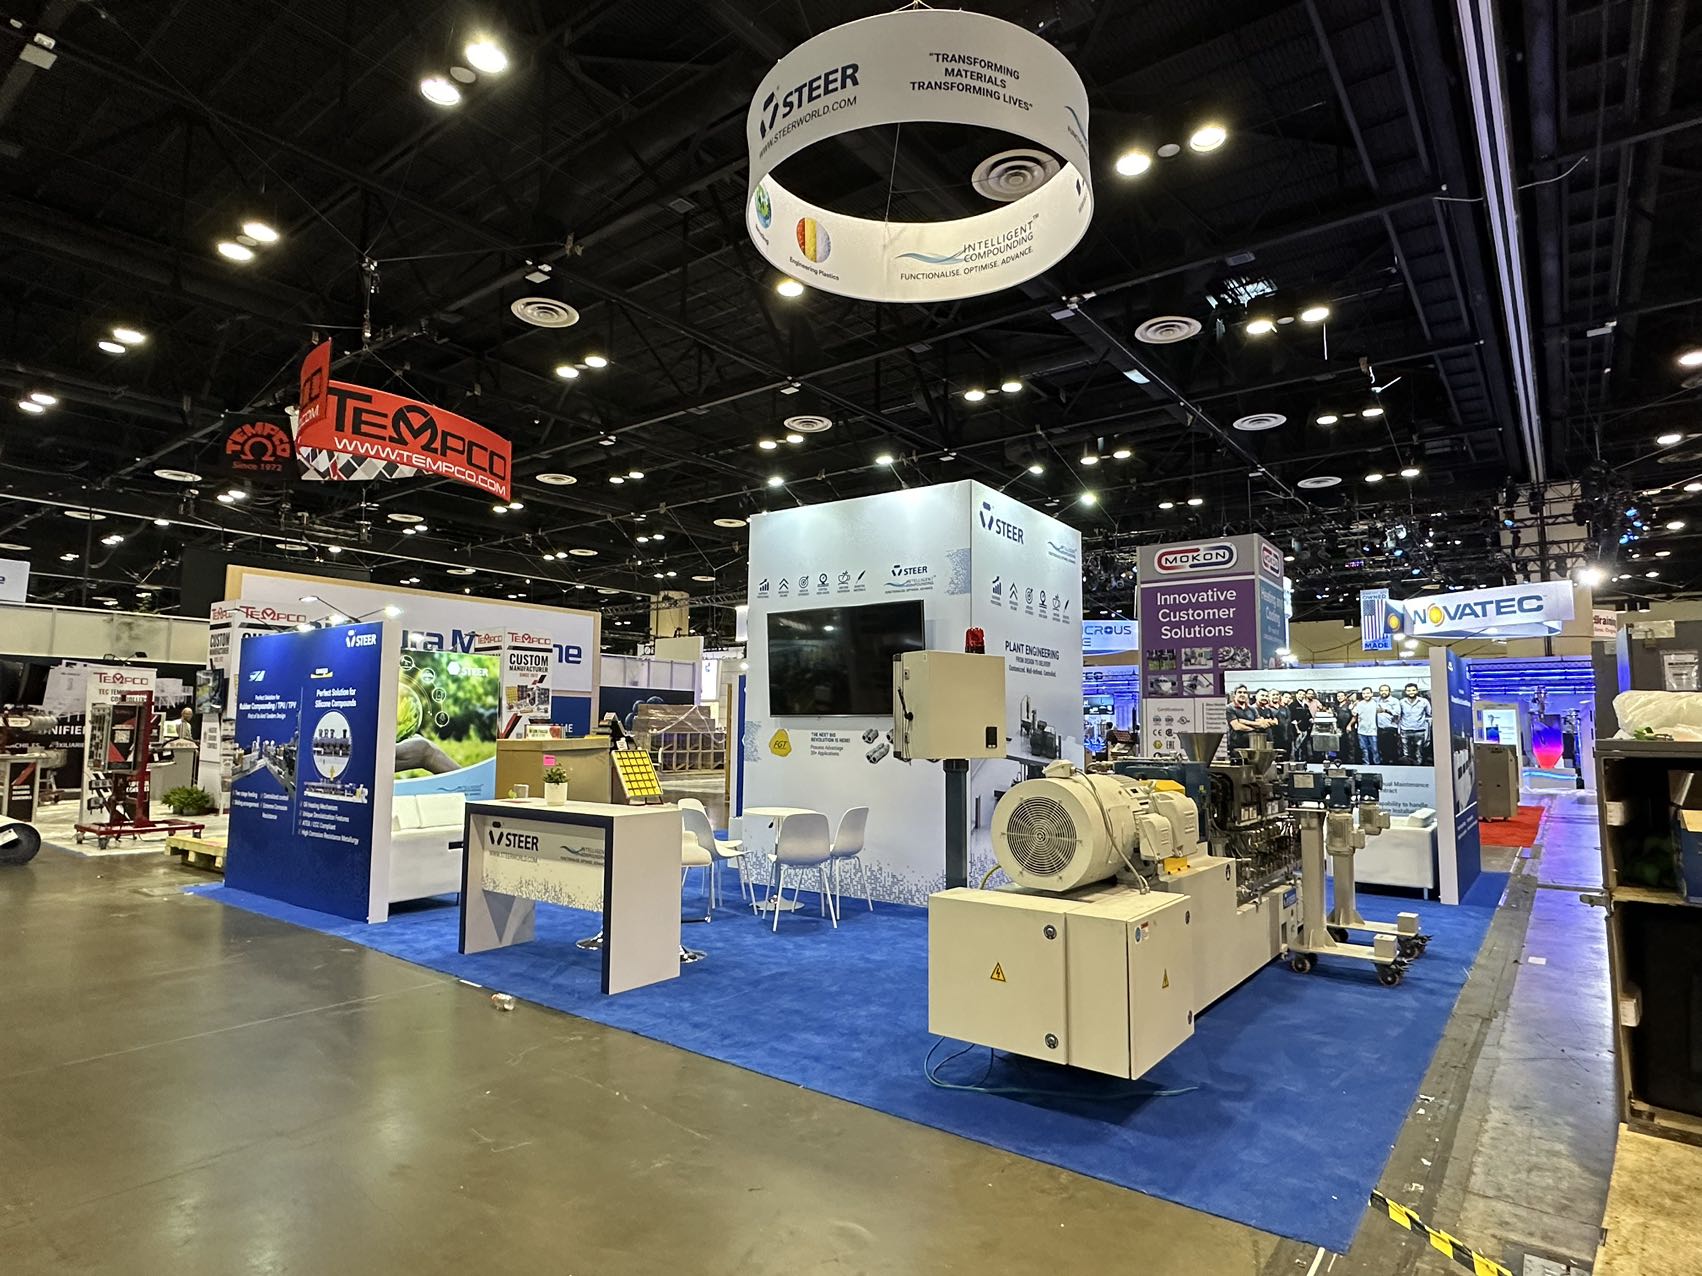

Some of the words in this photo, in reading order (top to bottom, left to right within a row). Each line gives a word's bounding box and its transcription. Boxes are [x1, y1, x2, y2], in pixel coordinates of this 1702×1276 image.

[944, 67, 1007, 89] MATERIALS
[782, 63, 859, 118] STEER
[910, 80, 1000, 100] TRANSFORMING
[760, 95, 857, 158] WWW.STEERWORLD.COM
[963, 220, 1033, 254] INTELLIGENT
[963, 231, 1033, 263] COMPOUNDING
[789, 256, 818, 275] Engineering
[818, 270, 839, 281] Plastics
[226, 421, 290, 459] TEMPCO
[327, 388, 506, 481] TEMPCO
[232, 460, 257, 471] Since
[334, 436, 506, 496] WWW.TEMPCO.COM
[995, 518, 1024, 545] STEER
[1164, 550, 1226, 565] MOKON
[904, 565, 928, 576] STEER
[1157, 588, 1237, 605] Innovative
[239, 606, 307, 622] TEMPCO
[1158, 606, 1236, 622] Customer
[1412, 594, 1544, 627] NOVATEC
[356, 634, 377, 647] STEER
[507, 632, 551, 645] TEMPCO
[1161, 624, 1233, 639] Solutions
[509, 653, 549, 666] CUSTOM
[1005, 640, 1025, 654] PLANT
[1025, 645, 1059, 660] ENGINEERING
[93, 672, 148, 685] TEMPCO
[509, 665, 549, 673] MANUFACTURER
[505, 833, 539, 851] STEER
